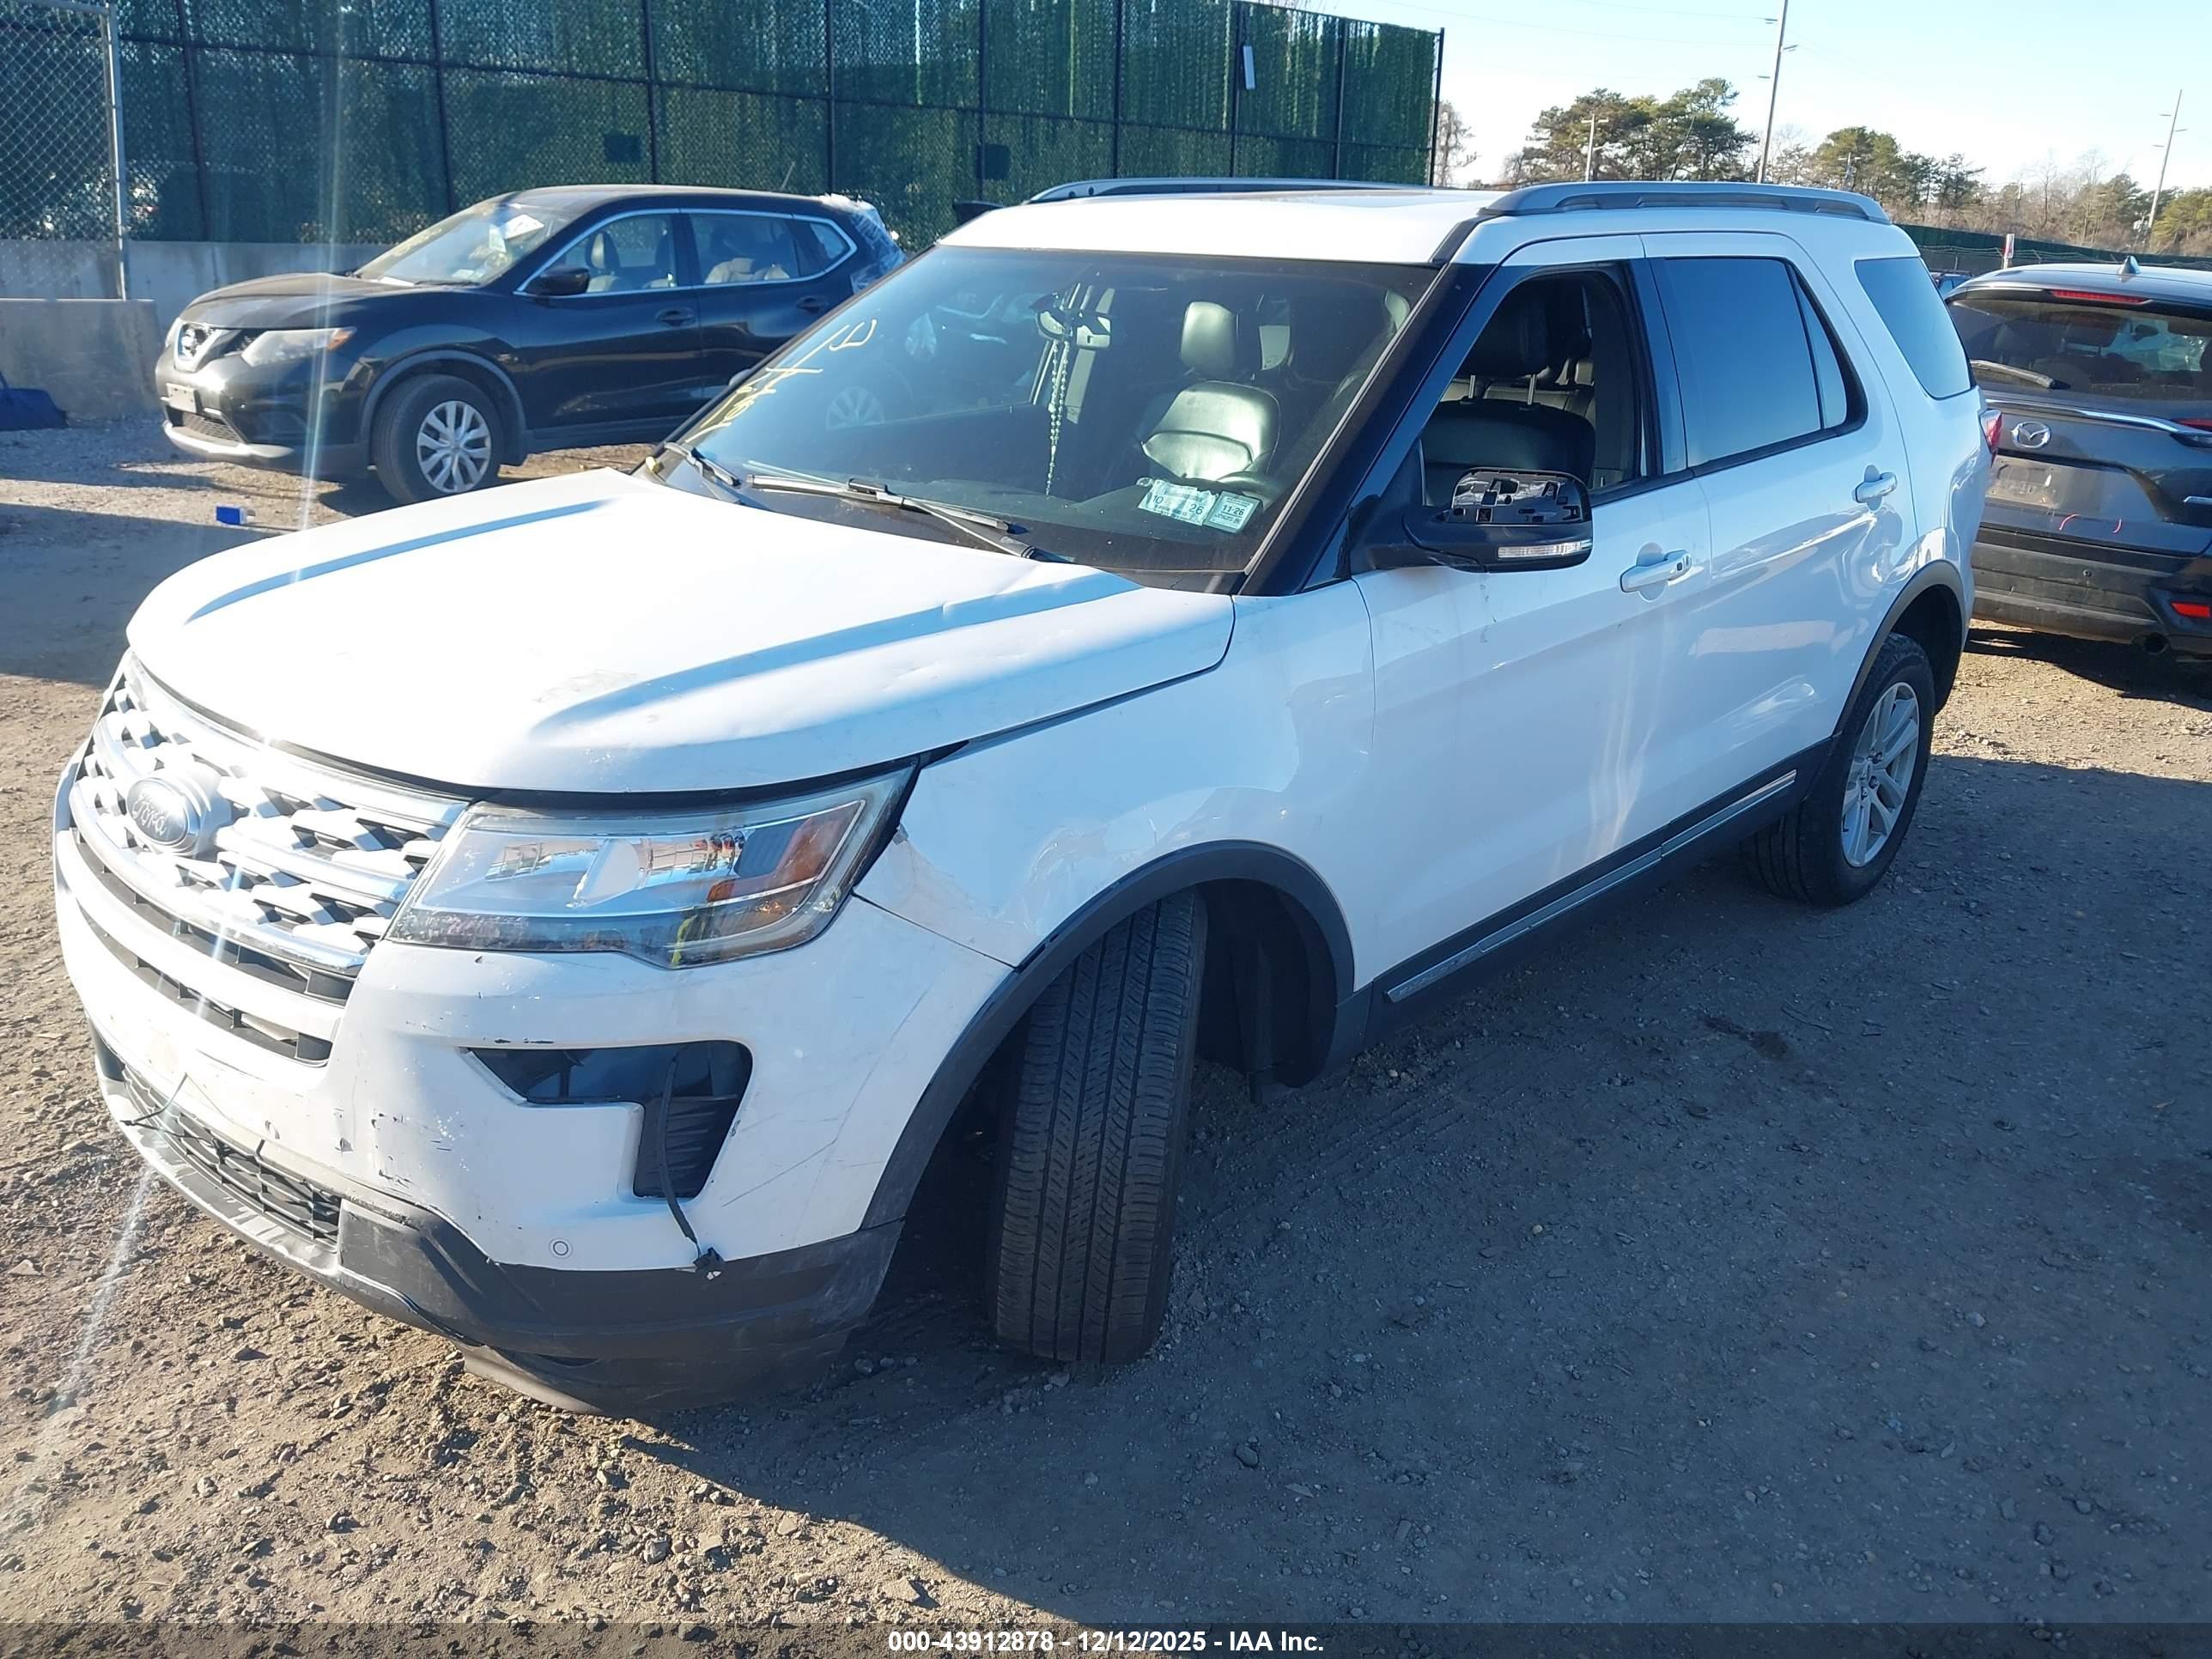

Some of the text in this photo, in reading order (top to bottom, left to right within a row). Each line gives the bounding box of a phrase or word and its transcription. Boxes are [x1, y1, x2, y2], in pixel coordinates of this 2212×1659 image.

[1152, 495, 1205, 515] 10 26
[132, 794, 171, 836] Ford
